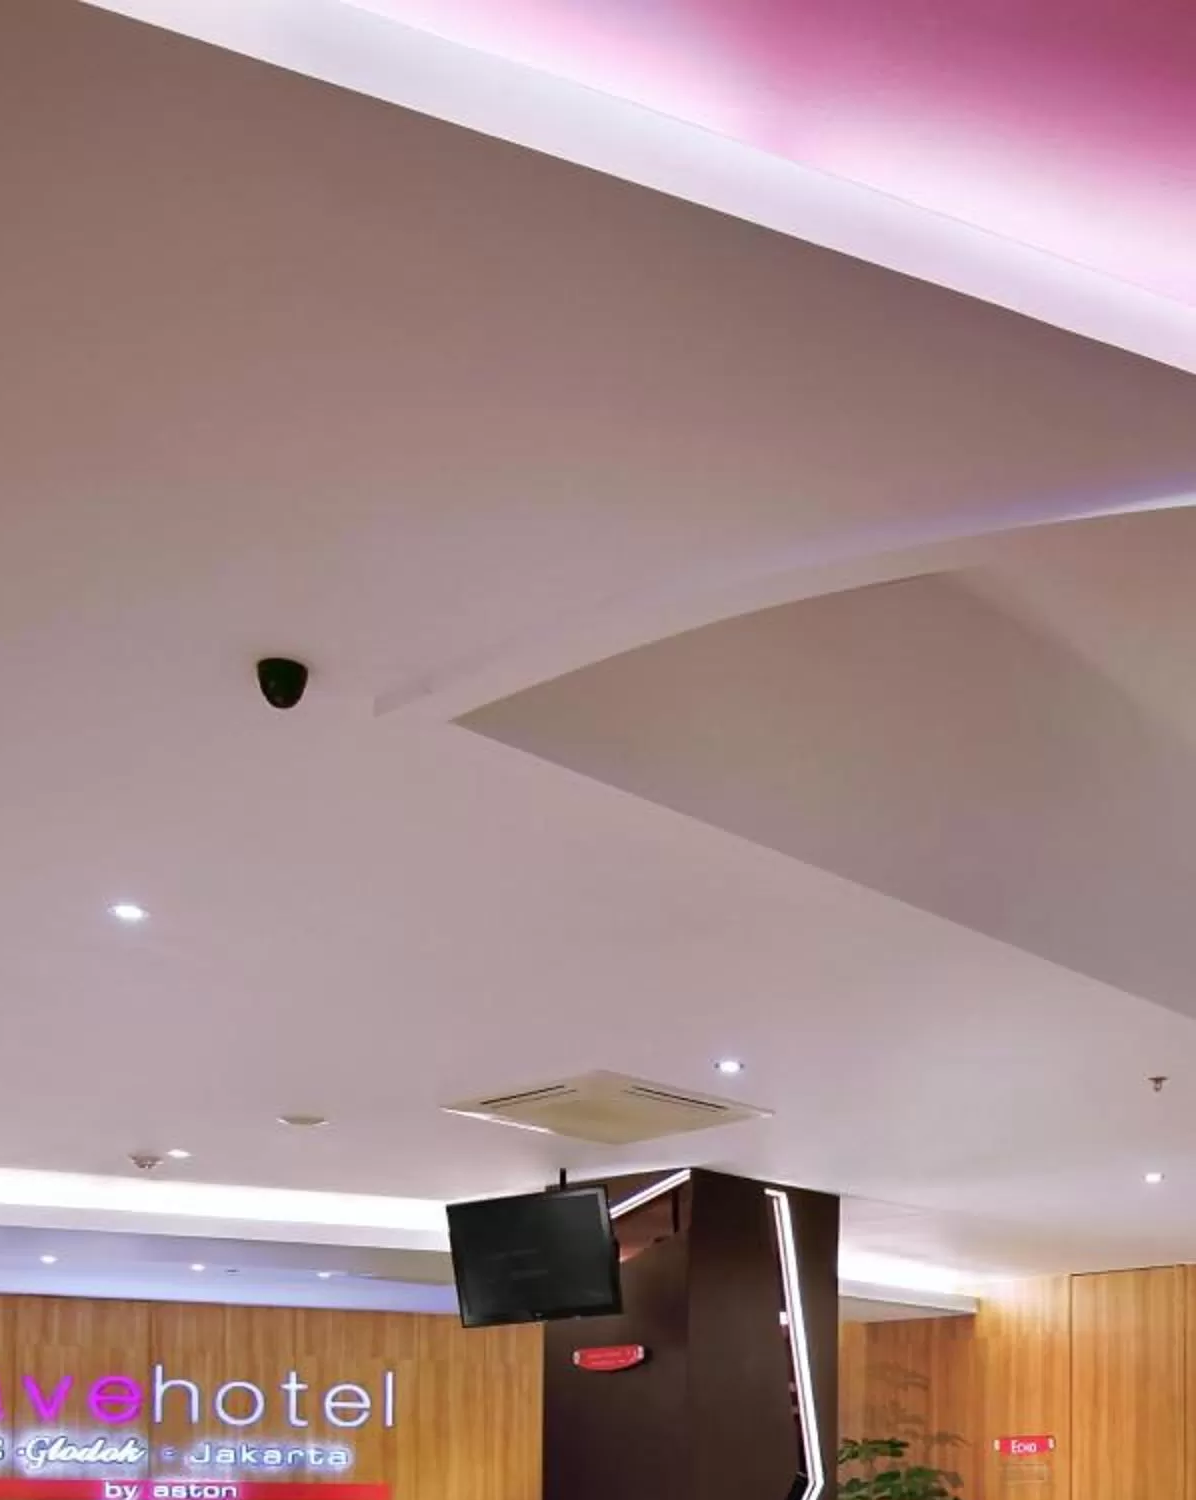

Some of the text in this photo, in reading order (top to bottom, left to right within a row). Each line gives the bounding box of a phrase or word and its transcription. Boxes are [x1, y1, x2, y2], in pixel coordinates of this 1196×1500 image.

[189, 1443, 349, 1466] Jakarta
[103, 1481, 238, 1500] by aston
